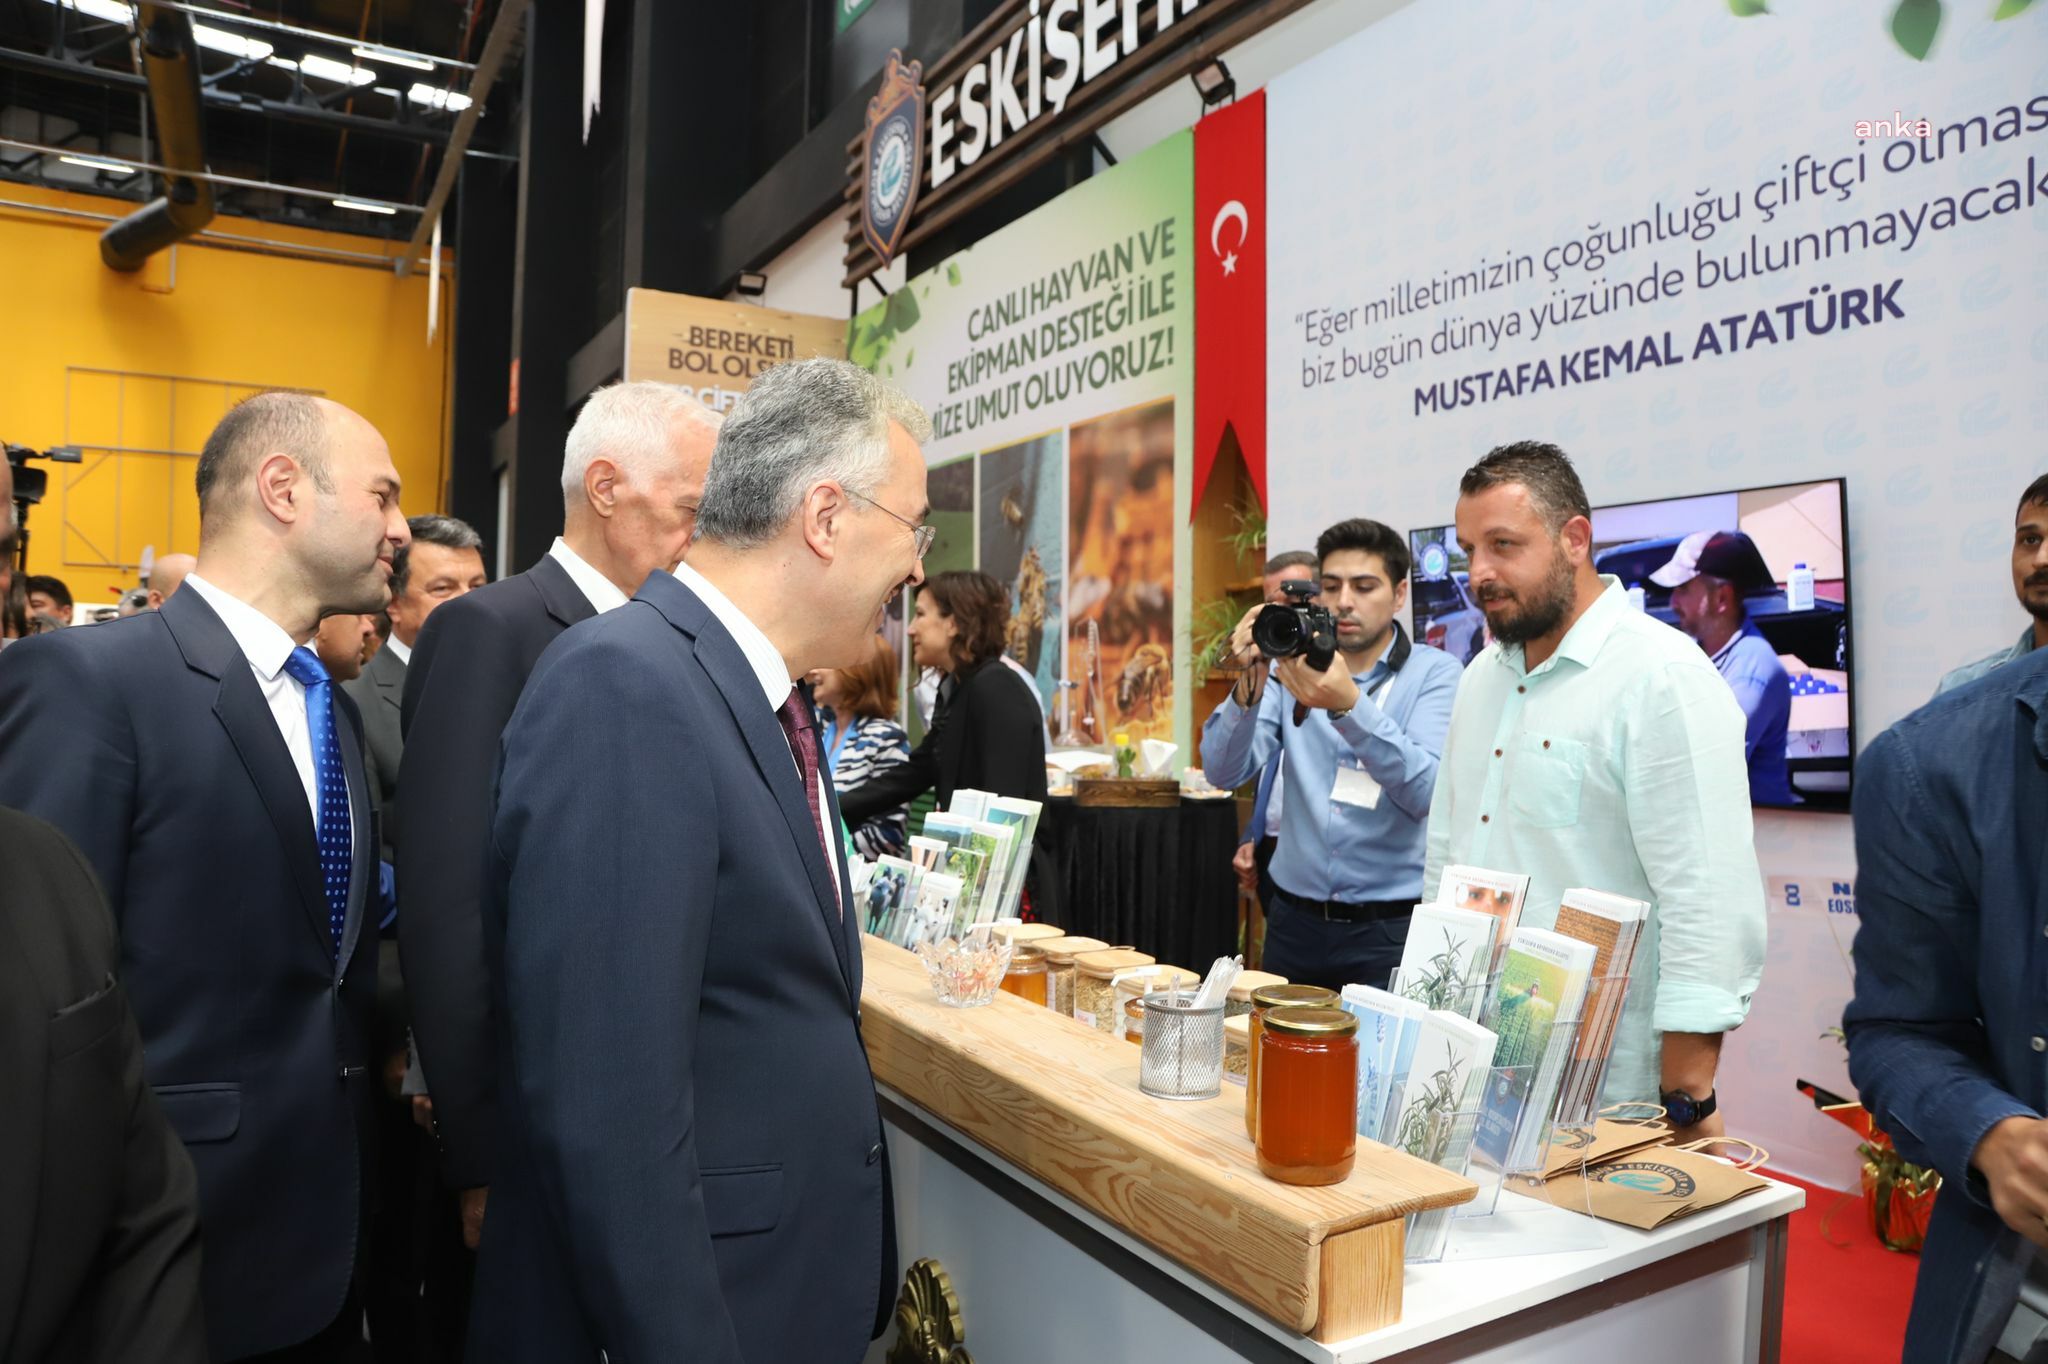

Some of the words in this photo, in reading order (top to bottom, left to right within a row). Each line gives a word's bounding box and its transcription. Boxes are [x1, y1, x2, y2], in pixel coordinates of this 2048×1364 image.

[967, 286, 1027, 342] CANLI
[1031, 236, 1133, 316] HAYVAN
[1138, 217, 1175, 266] VE
[1365, 250, 1533, 326] milletimizin
[1543, 188, 1741, 283] çoğunluğu
[1754, 141, 1866, 222] çiftçi
[669, 347, 719, 374] BOL
[689, 325, 794, 359] BEREKETİ
[948, 328, 1036, 394] EKİPMAN
[1041, 280, 1134, 358] DESTEĞİ
[1139, 271, 1175, 321] İLE
[966, 381, 1021, 430] UMUT
[1024, 326, 1175, 410] OLUYORUZ!
[1302, 355, 1336, 388] biz
[1342, 335, 1423, 379] bugün
[1431, 312, 1521, 354] dünya
[1529, 261, 1684, 341] yüzünde
[1414, 360, 1556, 417] MUSTAFA
[1560, 331, 1684, 386] KEMAL
[1692, 278, 1905, 360] ATATÜRK
